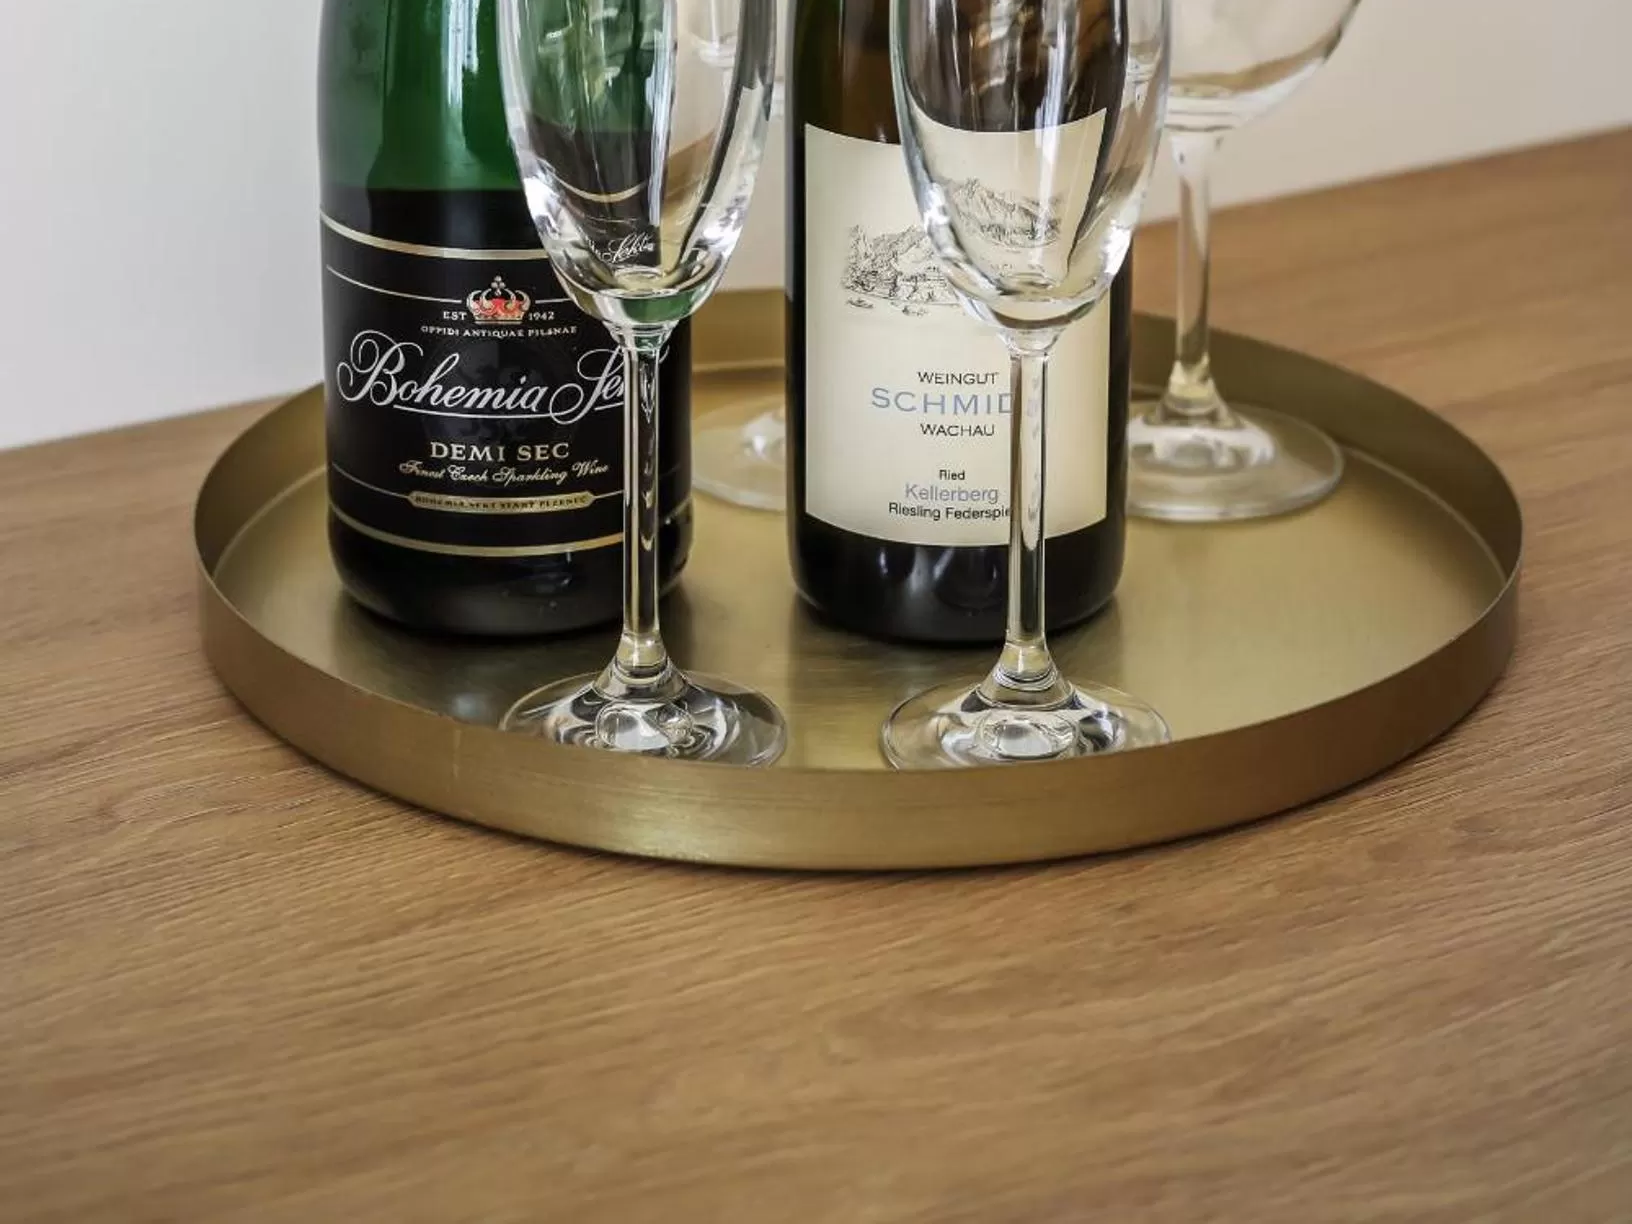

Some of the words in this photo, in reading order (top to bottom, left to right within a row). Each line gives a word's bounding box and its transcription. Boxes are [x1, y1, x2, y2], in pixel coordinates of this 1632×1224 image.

[443, 311, 467, 321] EST
[528, 311, 555, 321] 1942
[421, 326, 460, 336] OPPIDI
[462, 329, 524, 339] ANTIQUAE
[528, 326, 577, 336] PILSNAE
[337, 329, 549, 413] Bohemia
[917, 371, 999, 385] WEINGUT
[871, 387, 1014, 415] SCHMID
[920, 424, 995, 437] WACHAU
[430, 441, 505, 461] DEMI
[516, 442, 570, 461] SEC
[492, 466, 568, 487] Sparkling
[571, 459, 609, 477] Wine
[939, 469, 966, 481] Ried
[905, 483, 999, 504] Kellerberg
[889, 502, 941, 521] Riesling
